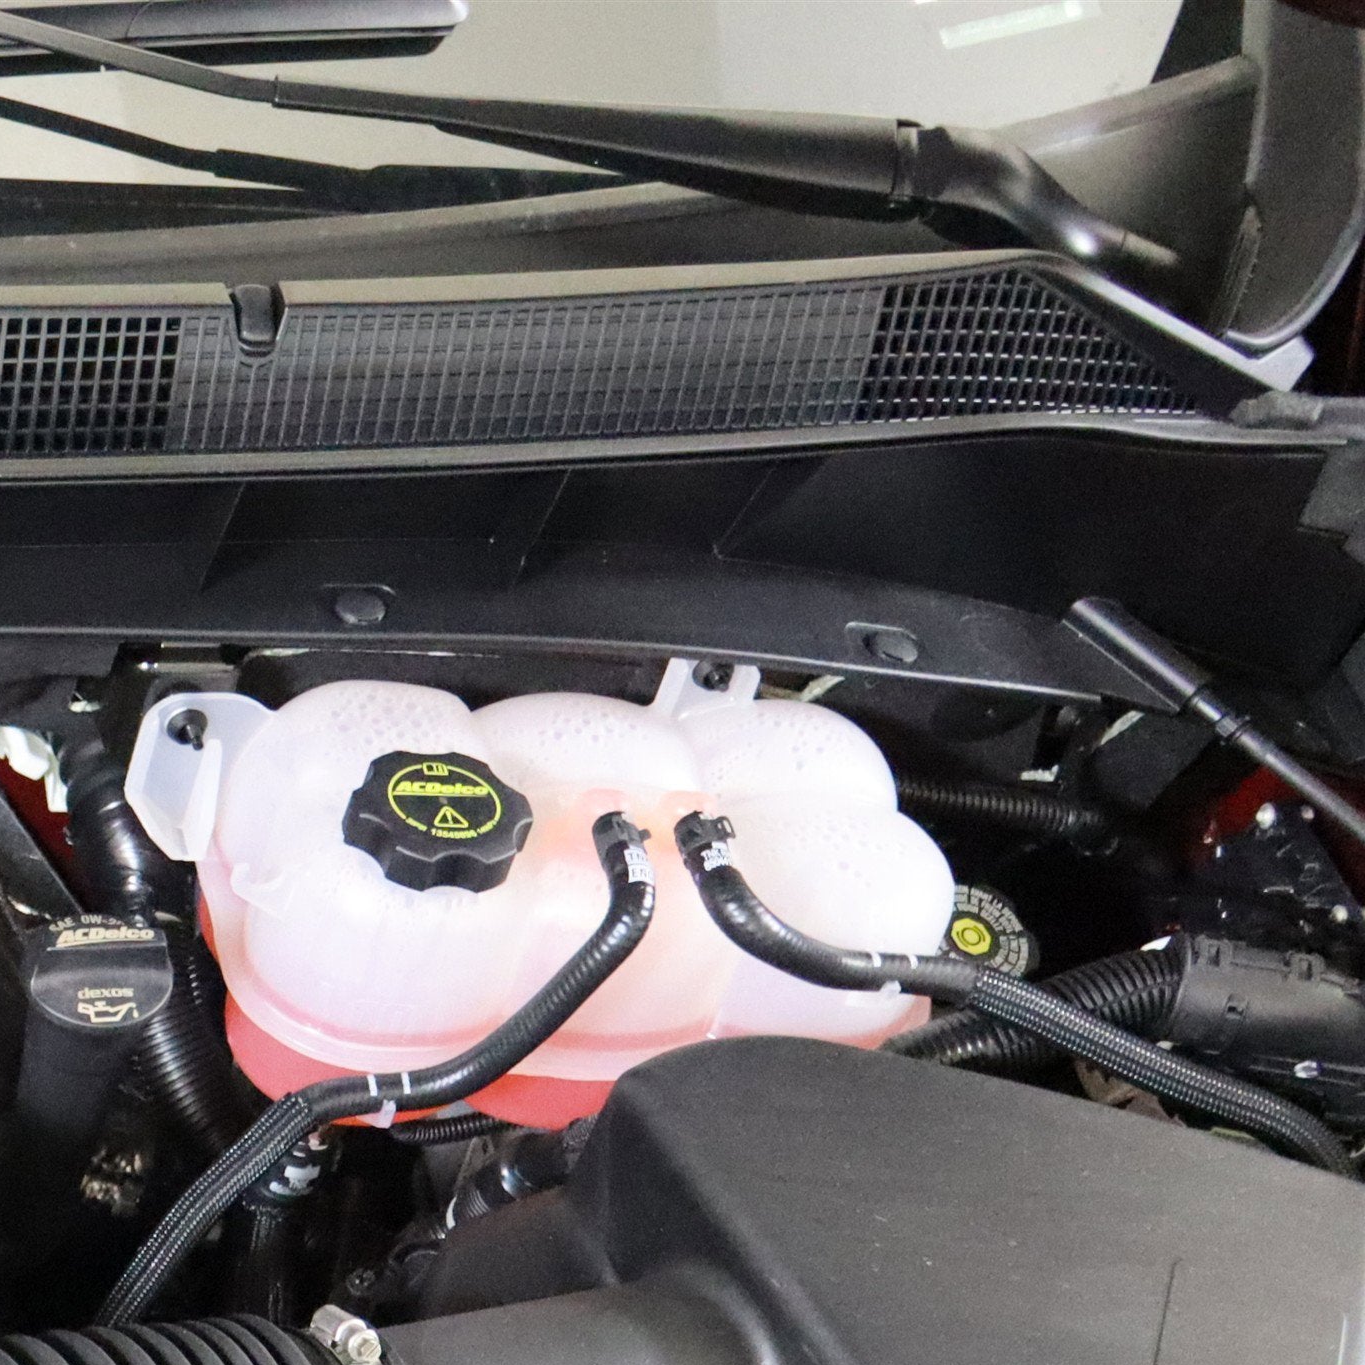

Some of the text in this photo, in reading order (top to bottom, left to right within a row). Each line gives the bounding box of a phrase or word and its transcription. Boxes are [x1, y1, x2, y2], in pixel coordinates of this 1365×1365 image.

[394, 781, 491, 796] ACDelco
[49, 916, 76, 932] SAE
[56, 926, 155, 945] ACDelco
[77, 987, 135, 1000] dexos
